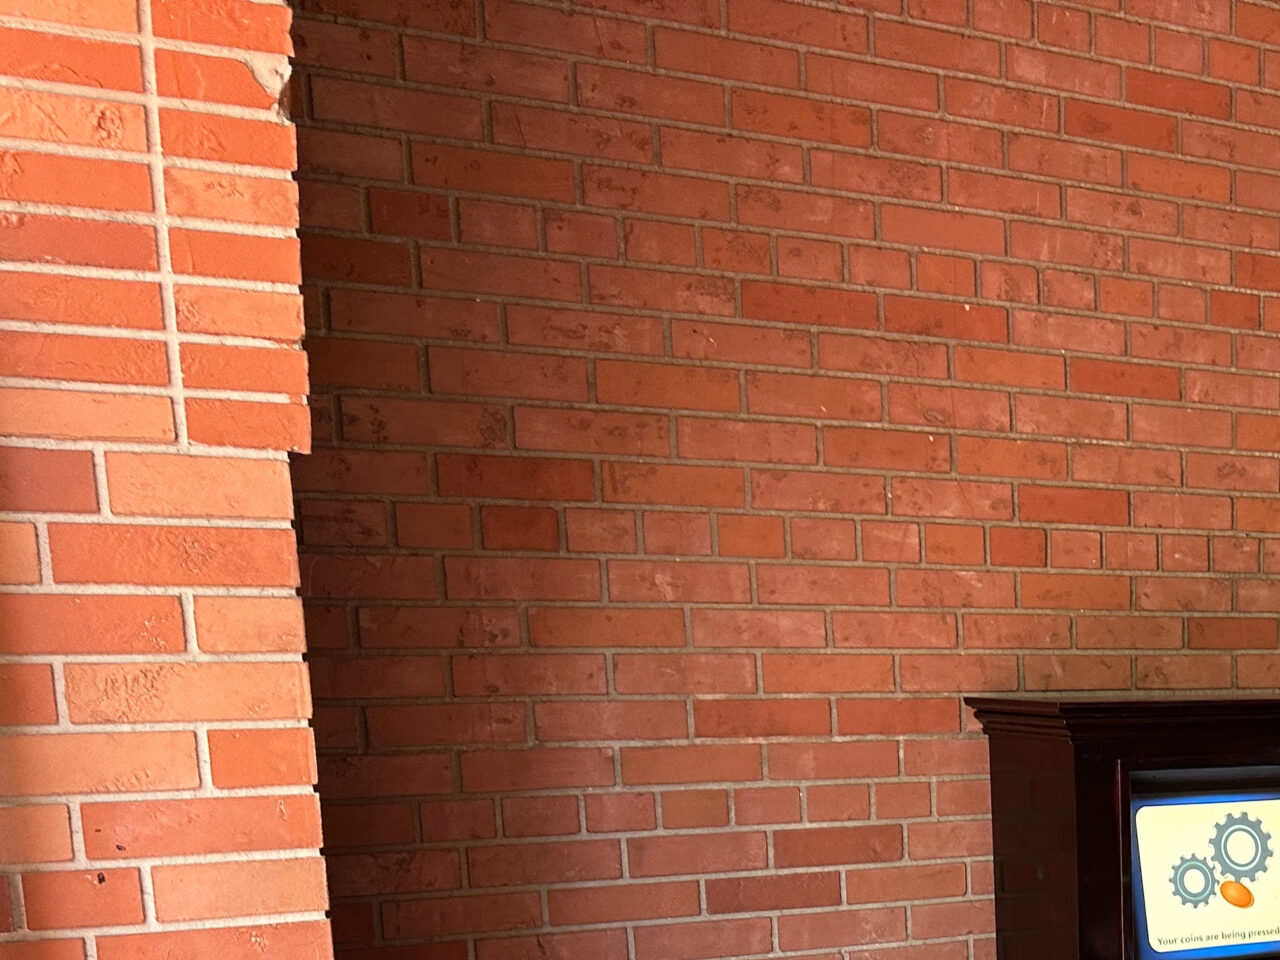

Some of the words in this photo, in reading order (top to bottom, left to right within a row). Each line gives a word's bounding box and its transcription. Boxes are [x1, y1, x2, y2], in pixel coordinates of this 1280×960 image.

[1157, 936, 1177, 946] Your
[1180, 934, 1203, 944] coins
[1205, 932, 1219, 941] are
[1221, 930, 1246, 940] being
[1248, 926, 1280, 938] pressed
